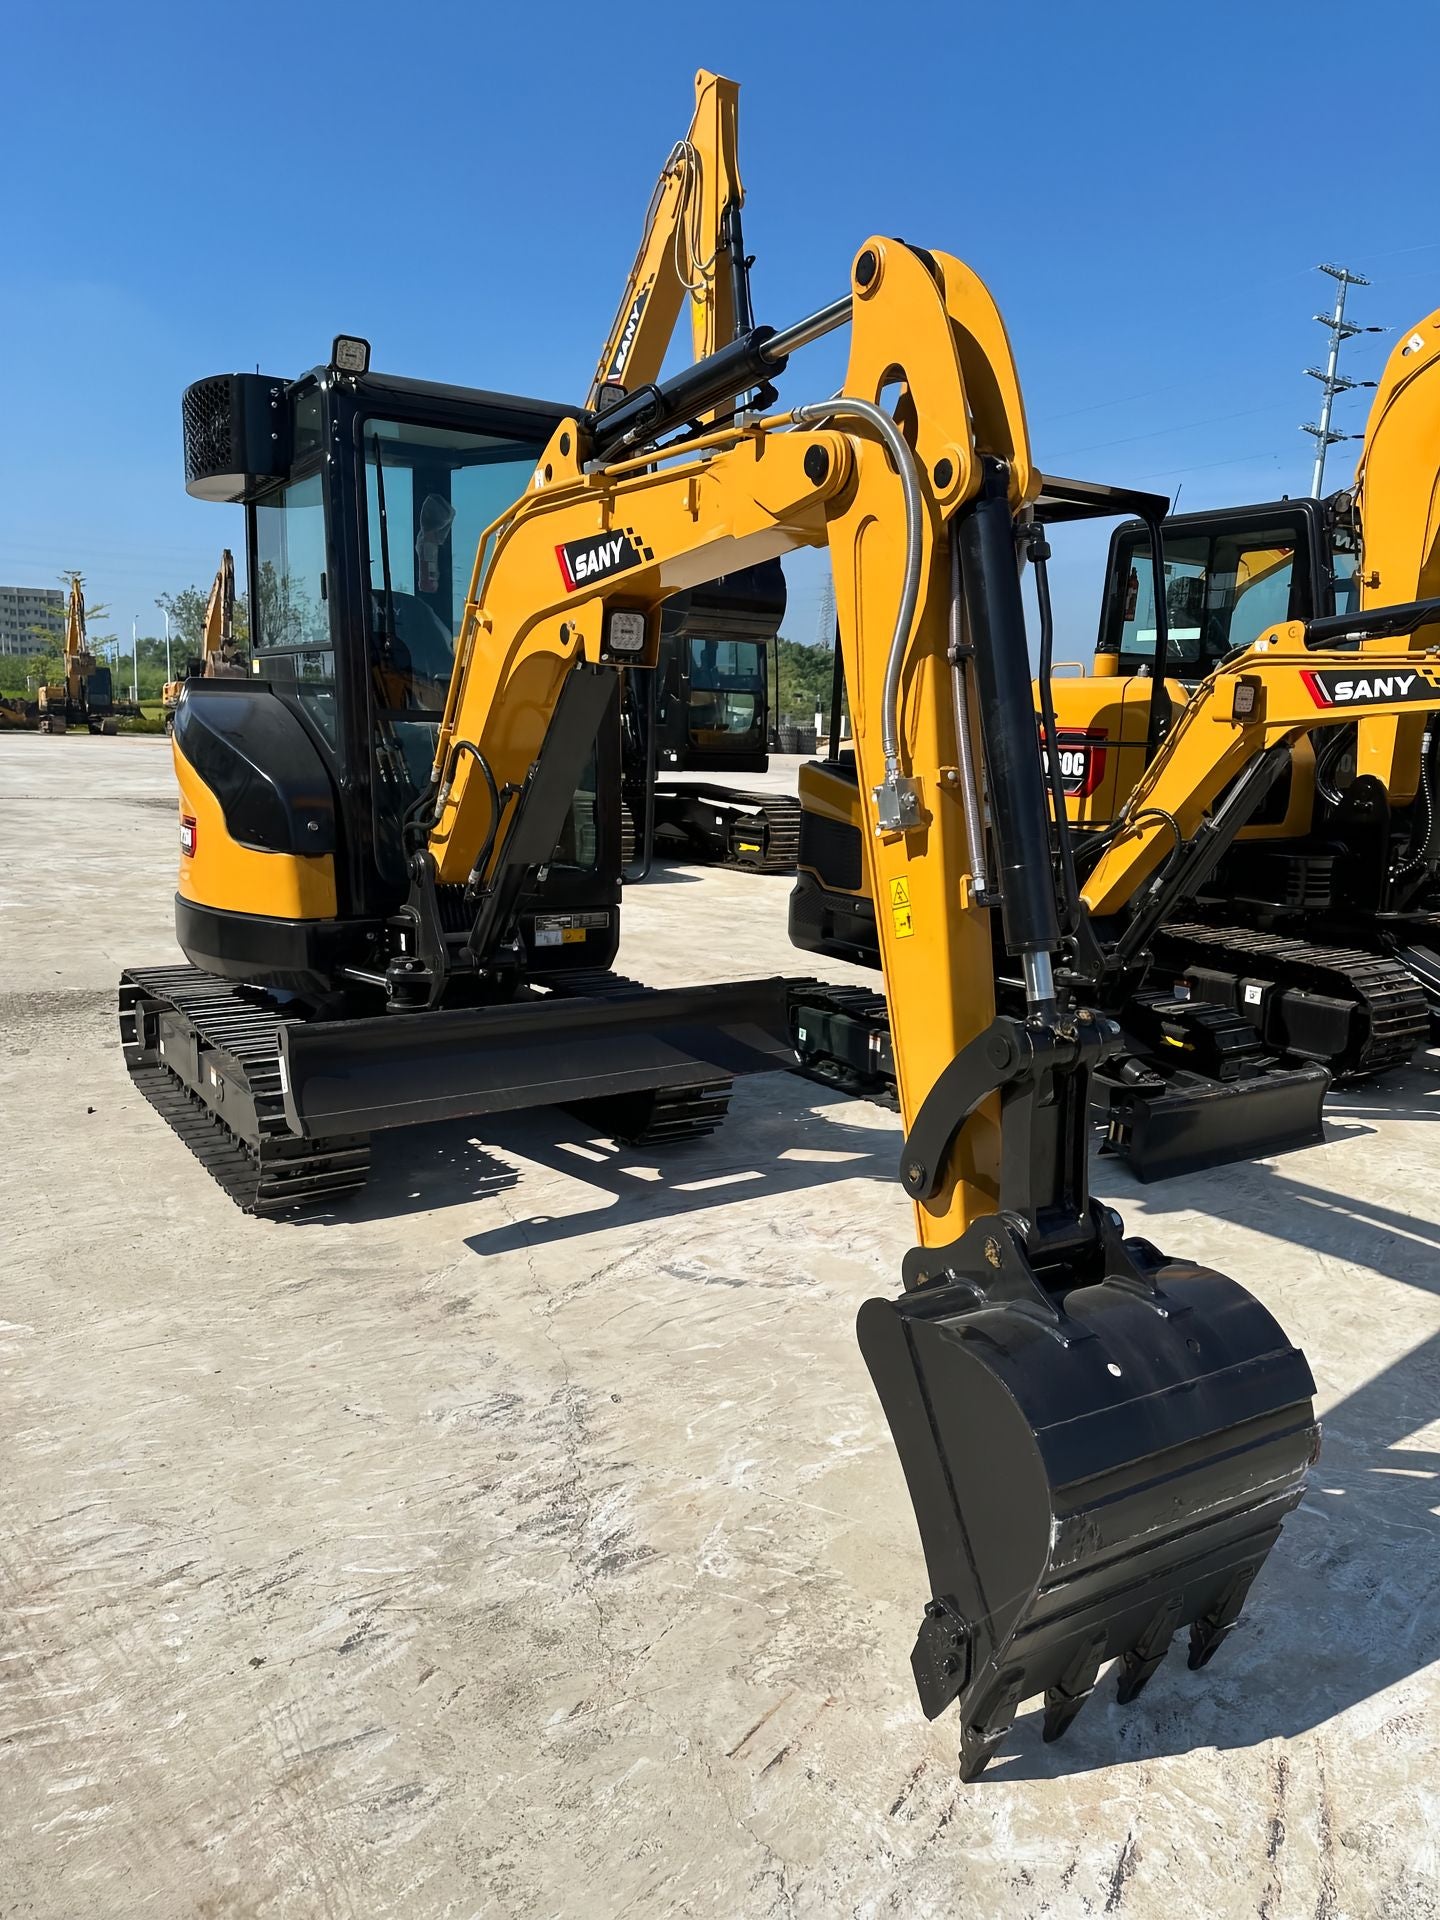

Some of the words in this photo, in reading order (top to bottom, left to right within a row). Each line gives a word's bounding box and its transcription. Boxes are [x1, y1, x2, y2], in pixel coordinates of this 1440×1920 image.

[616, 302, 640, 372] SANY
[575, 536, 624, 581] SANY
[1335, 675, 1417, 701] SANY
